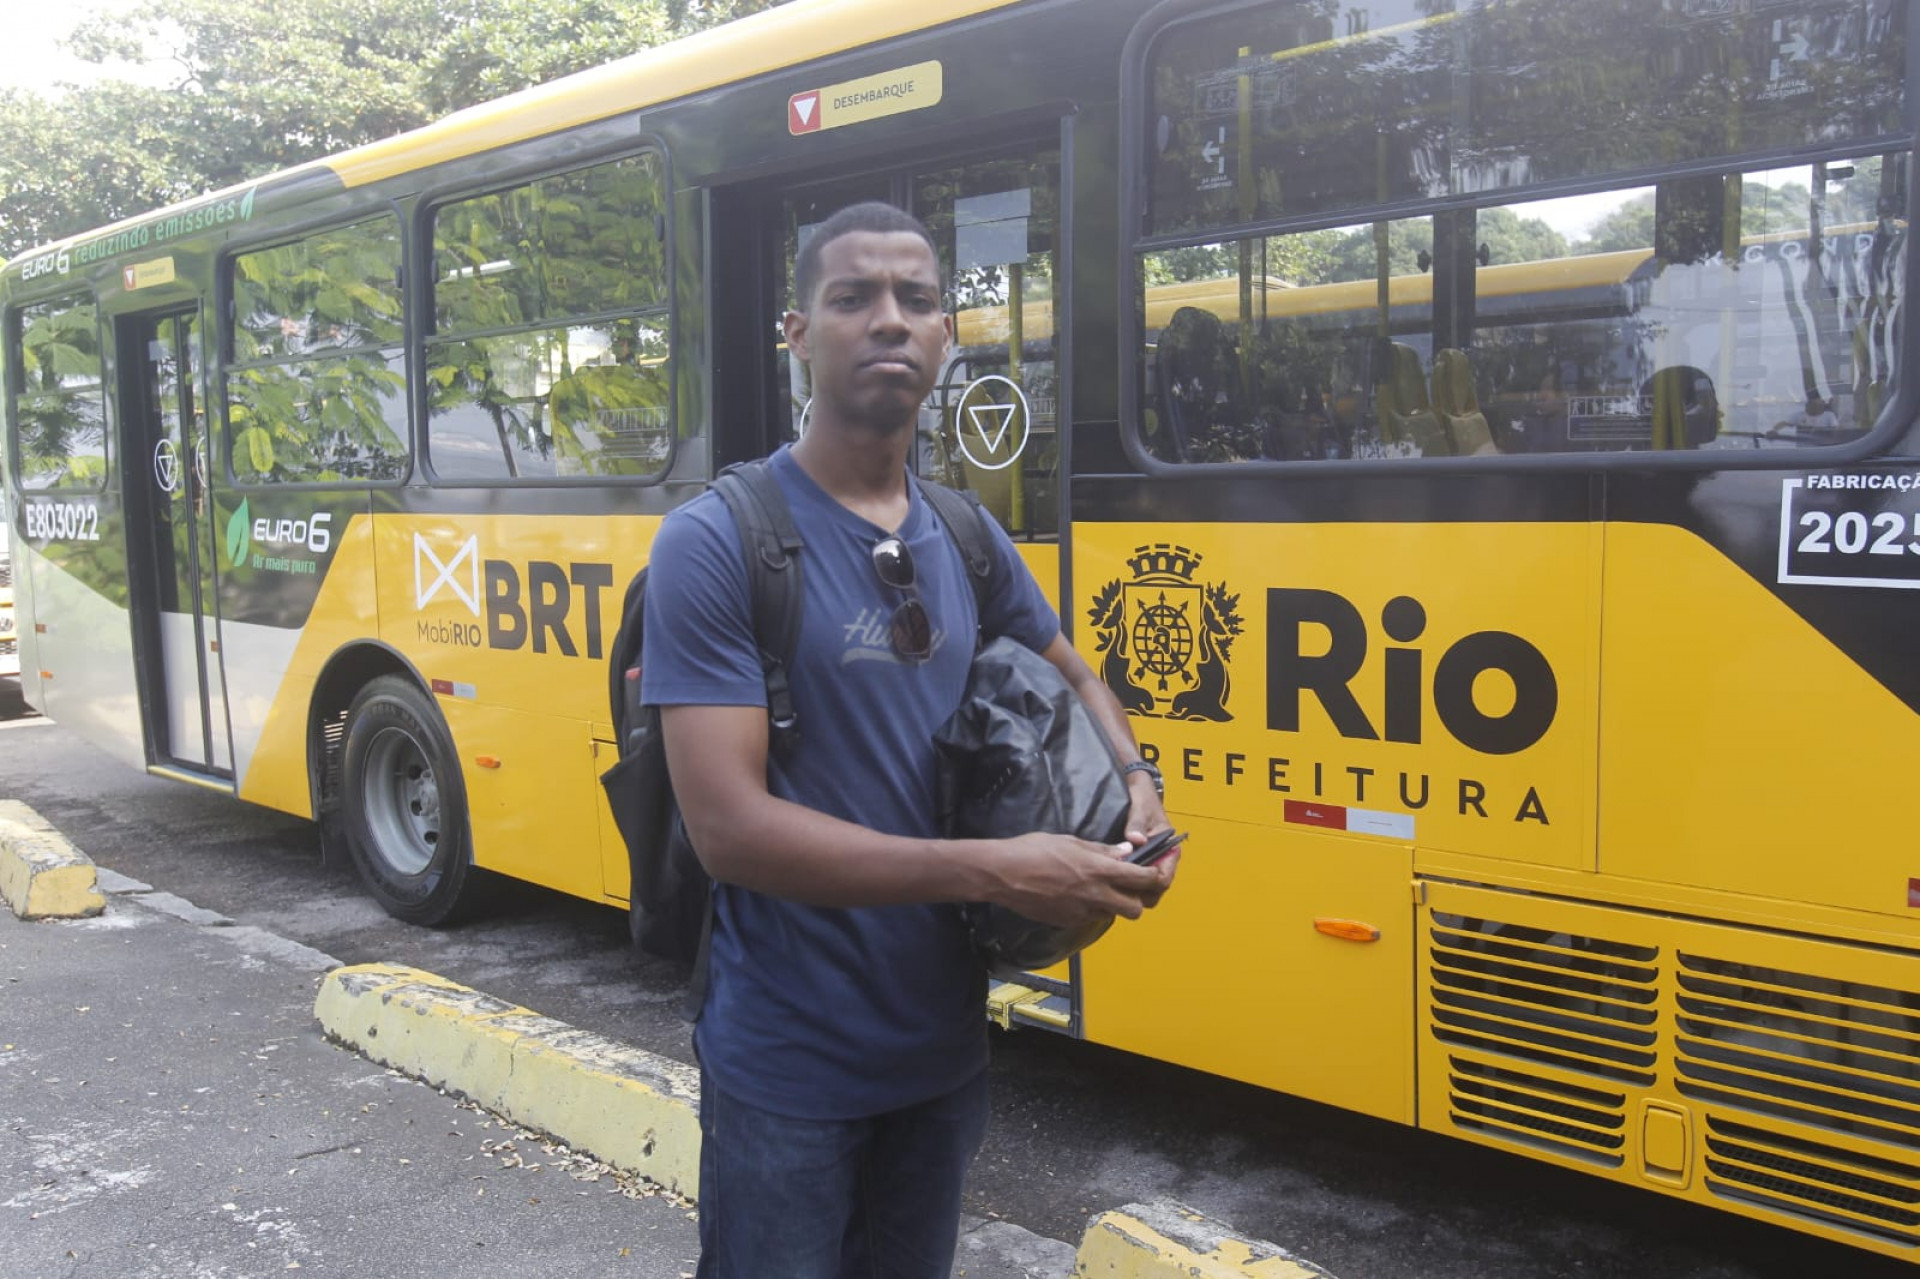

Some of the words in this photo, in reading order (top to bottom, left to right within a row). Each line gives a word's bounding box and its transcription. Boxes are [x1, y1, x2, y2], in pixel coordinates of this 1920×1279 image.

[834, 81, 914, 110] DESEMBARQUE
[75, 224, 148, 264] reduzindo
[25, 503, 99, 541] E803022
[265, 556, 289, 572] mais
[291, 560, 316, 575] puro
[484, 560, 613, 660] BRT
[417, 617, 482, 648] MobiRIO
[1267, 588, 1558, 755] Rio
[1140, 743, 1550, 825] REFEITURA
